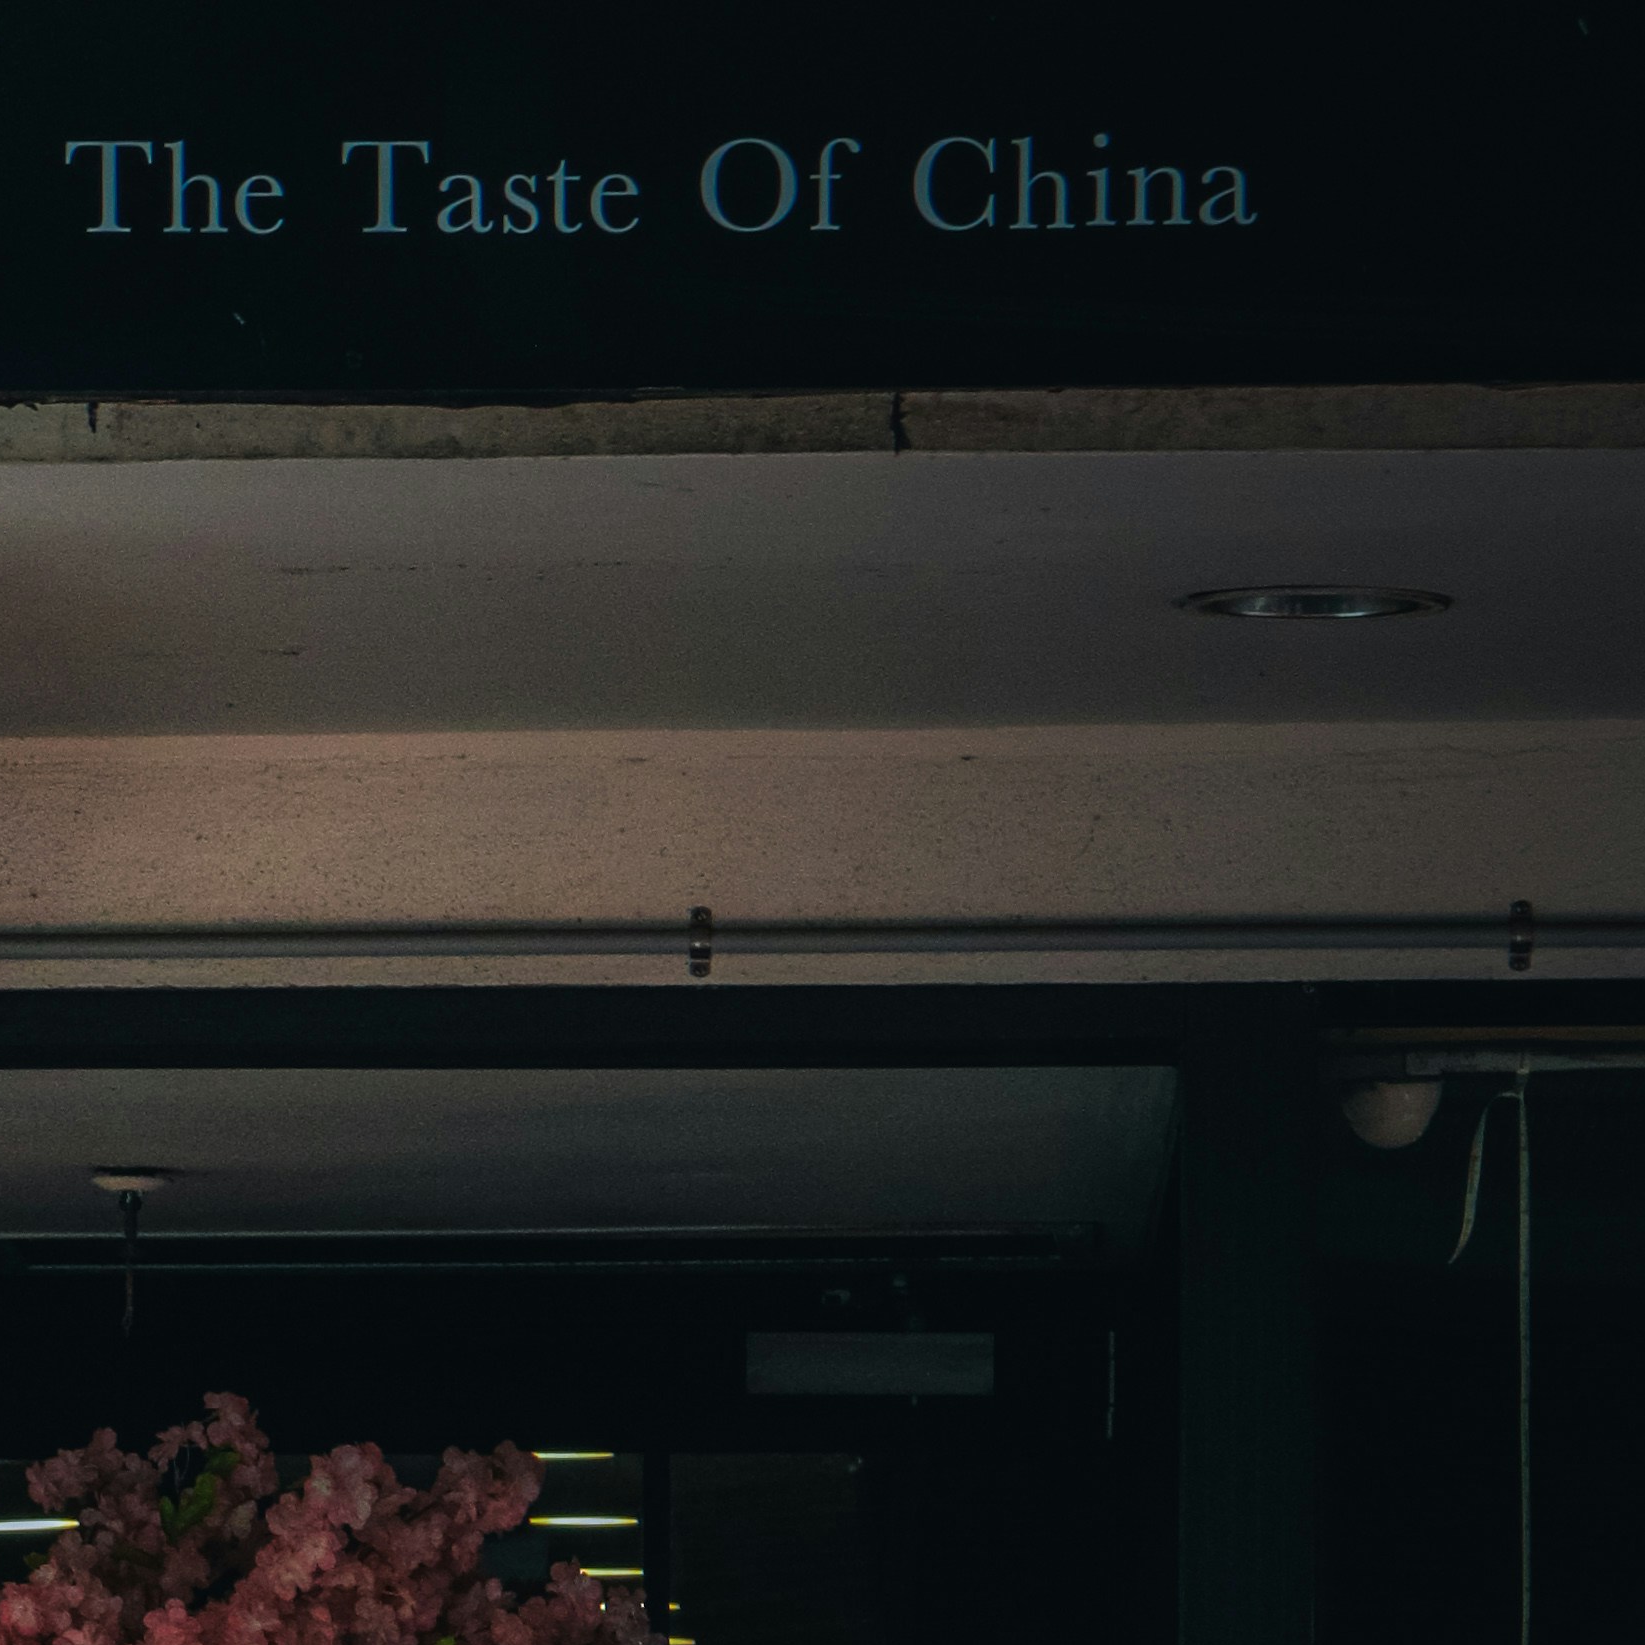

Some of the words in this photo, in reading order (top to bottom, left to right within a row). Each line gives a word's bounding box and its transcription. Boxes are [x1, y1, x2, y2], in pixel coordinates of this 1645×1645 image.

[63, 140, 285, 235] The
[340, 140, 641, 236] Taste
[699, 137, 862, 234] Of
[911, 132, 1258, 233] China
